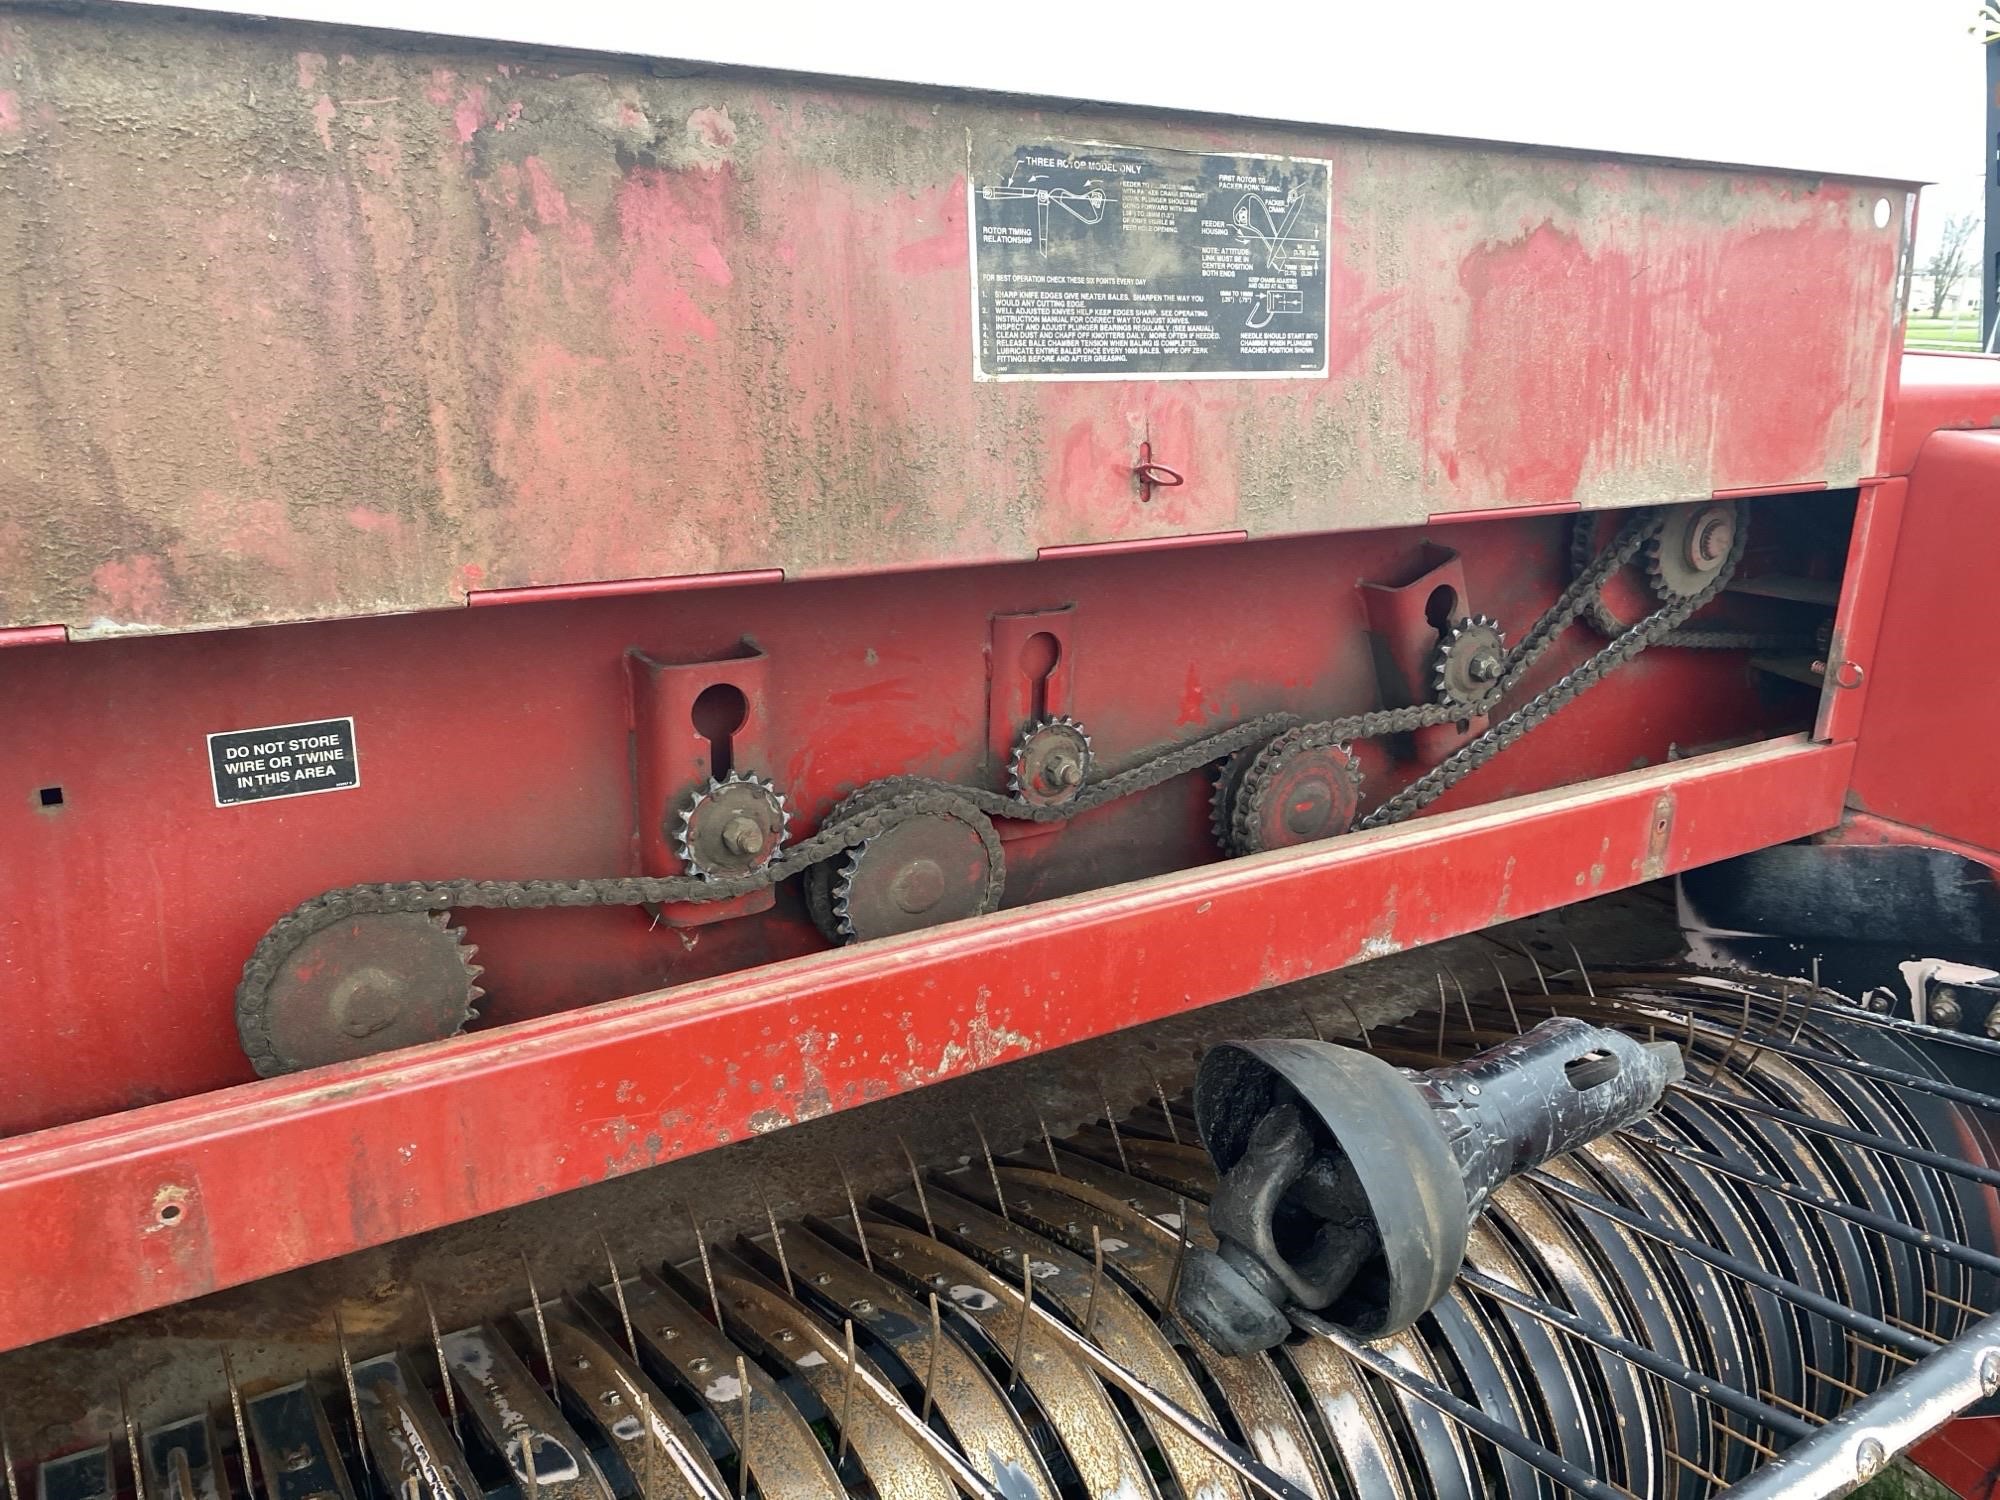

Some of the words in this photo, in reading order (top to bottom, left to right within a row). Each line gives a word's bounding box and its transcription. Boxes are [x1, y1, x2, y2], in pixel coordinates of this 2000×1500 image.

[1026, 157, 1055, 168] THREE
[1089, 162, 1117, 172] MODEL
[1120, 164, 1141, 174] ONLY
[983, 235, 1032, 244] RELATIONSHIP
[1008, 228, 1032, 236] TIMING
[226, 746, 249, 760] DO
[254, 742, 285, 756] NOT
[289, 734, 340, 751] STORE
[225, 759, 265, 775] WIRE
[269, 756, 292, 769] OR
[295, 749, 344, 764] TWINE
[237, 776, 253, 789] IN
[255, 771, 290, 786] THIS
[294, 765, 336, 780] AREA
